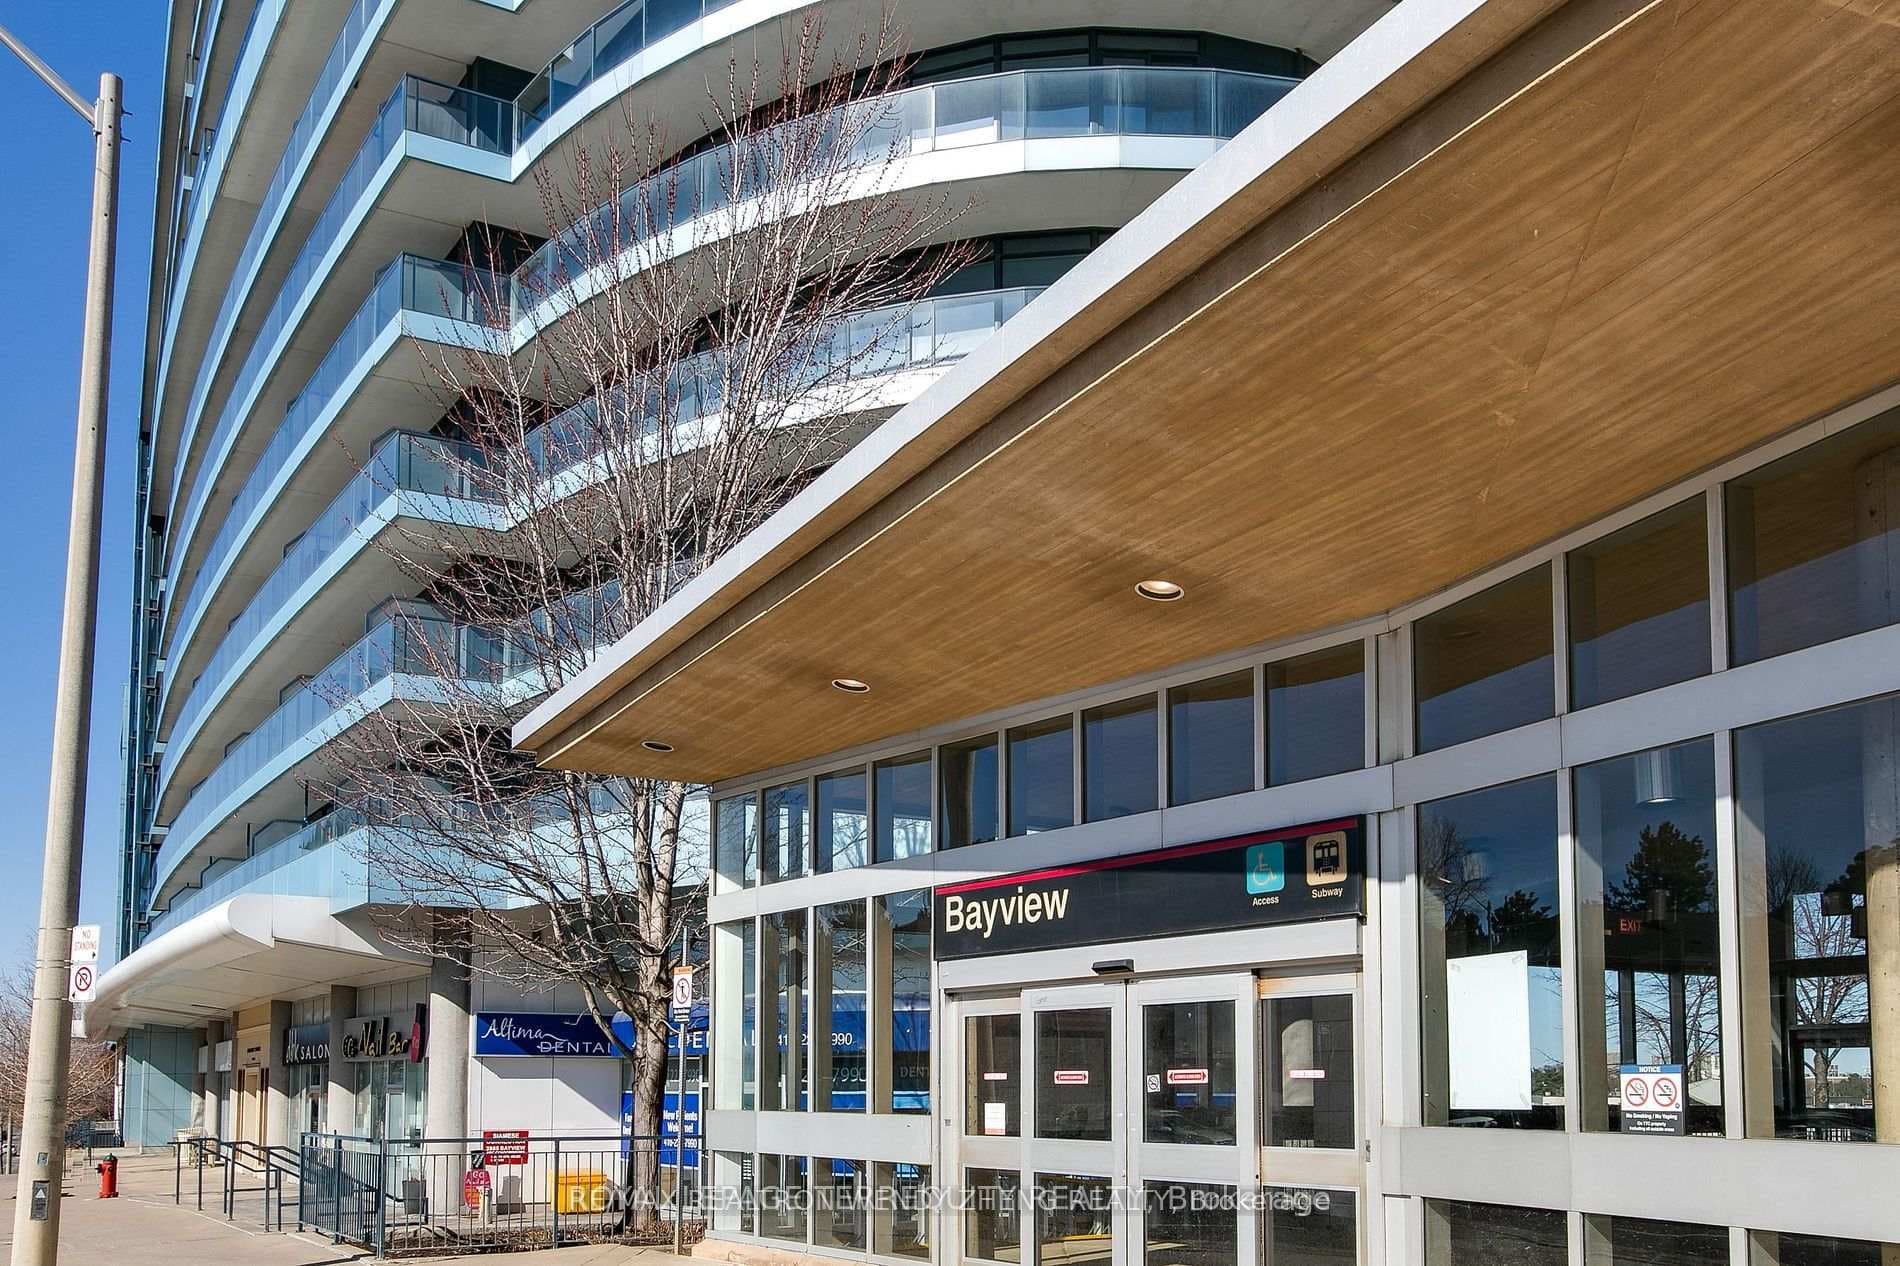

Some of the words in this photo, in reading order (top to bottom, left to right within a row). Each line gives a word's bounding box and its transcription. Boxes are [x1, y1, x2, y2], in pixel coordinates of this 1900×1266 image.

[1311, 887, 1344, 899] Subway
[1252, 896, 1280, 907] Access
[945, 885, 1069, 939] Bayview
[1620, 919, 1641, 931] EXIT
[82, 930, 91, 939] NO
[481, 1017, 560, 1041] Altima
[359, 1018, 384, 1057] Nail
[389, 1031, 409, 1056] Bar
[300, 1043, 331, 1061] SALON
